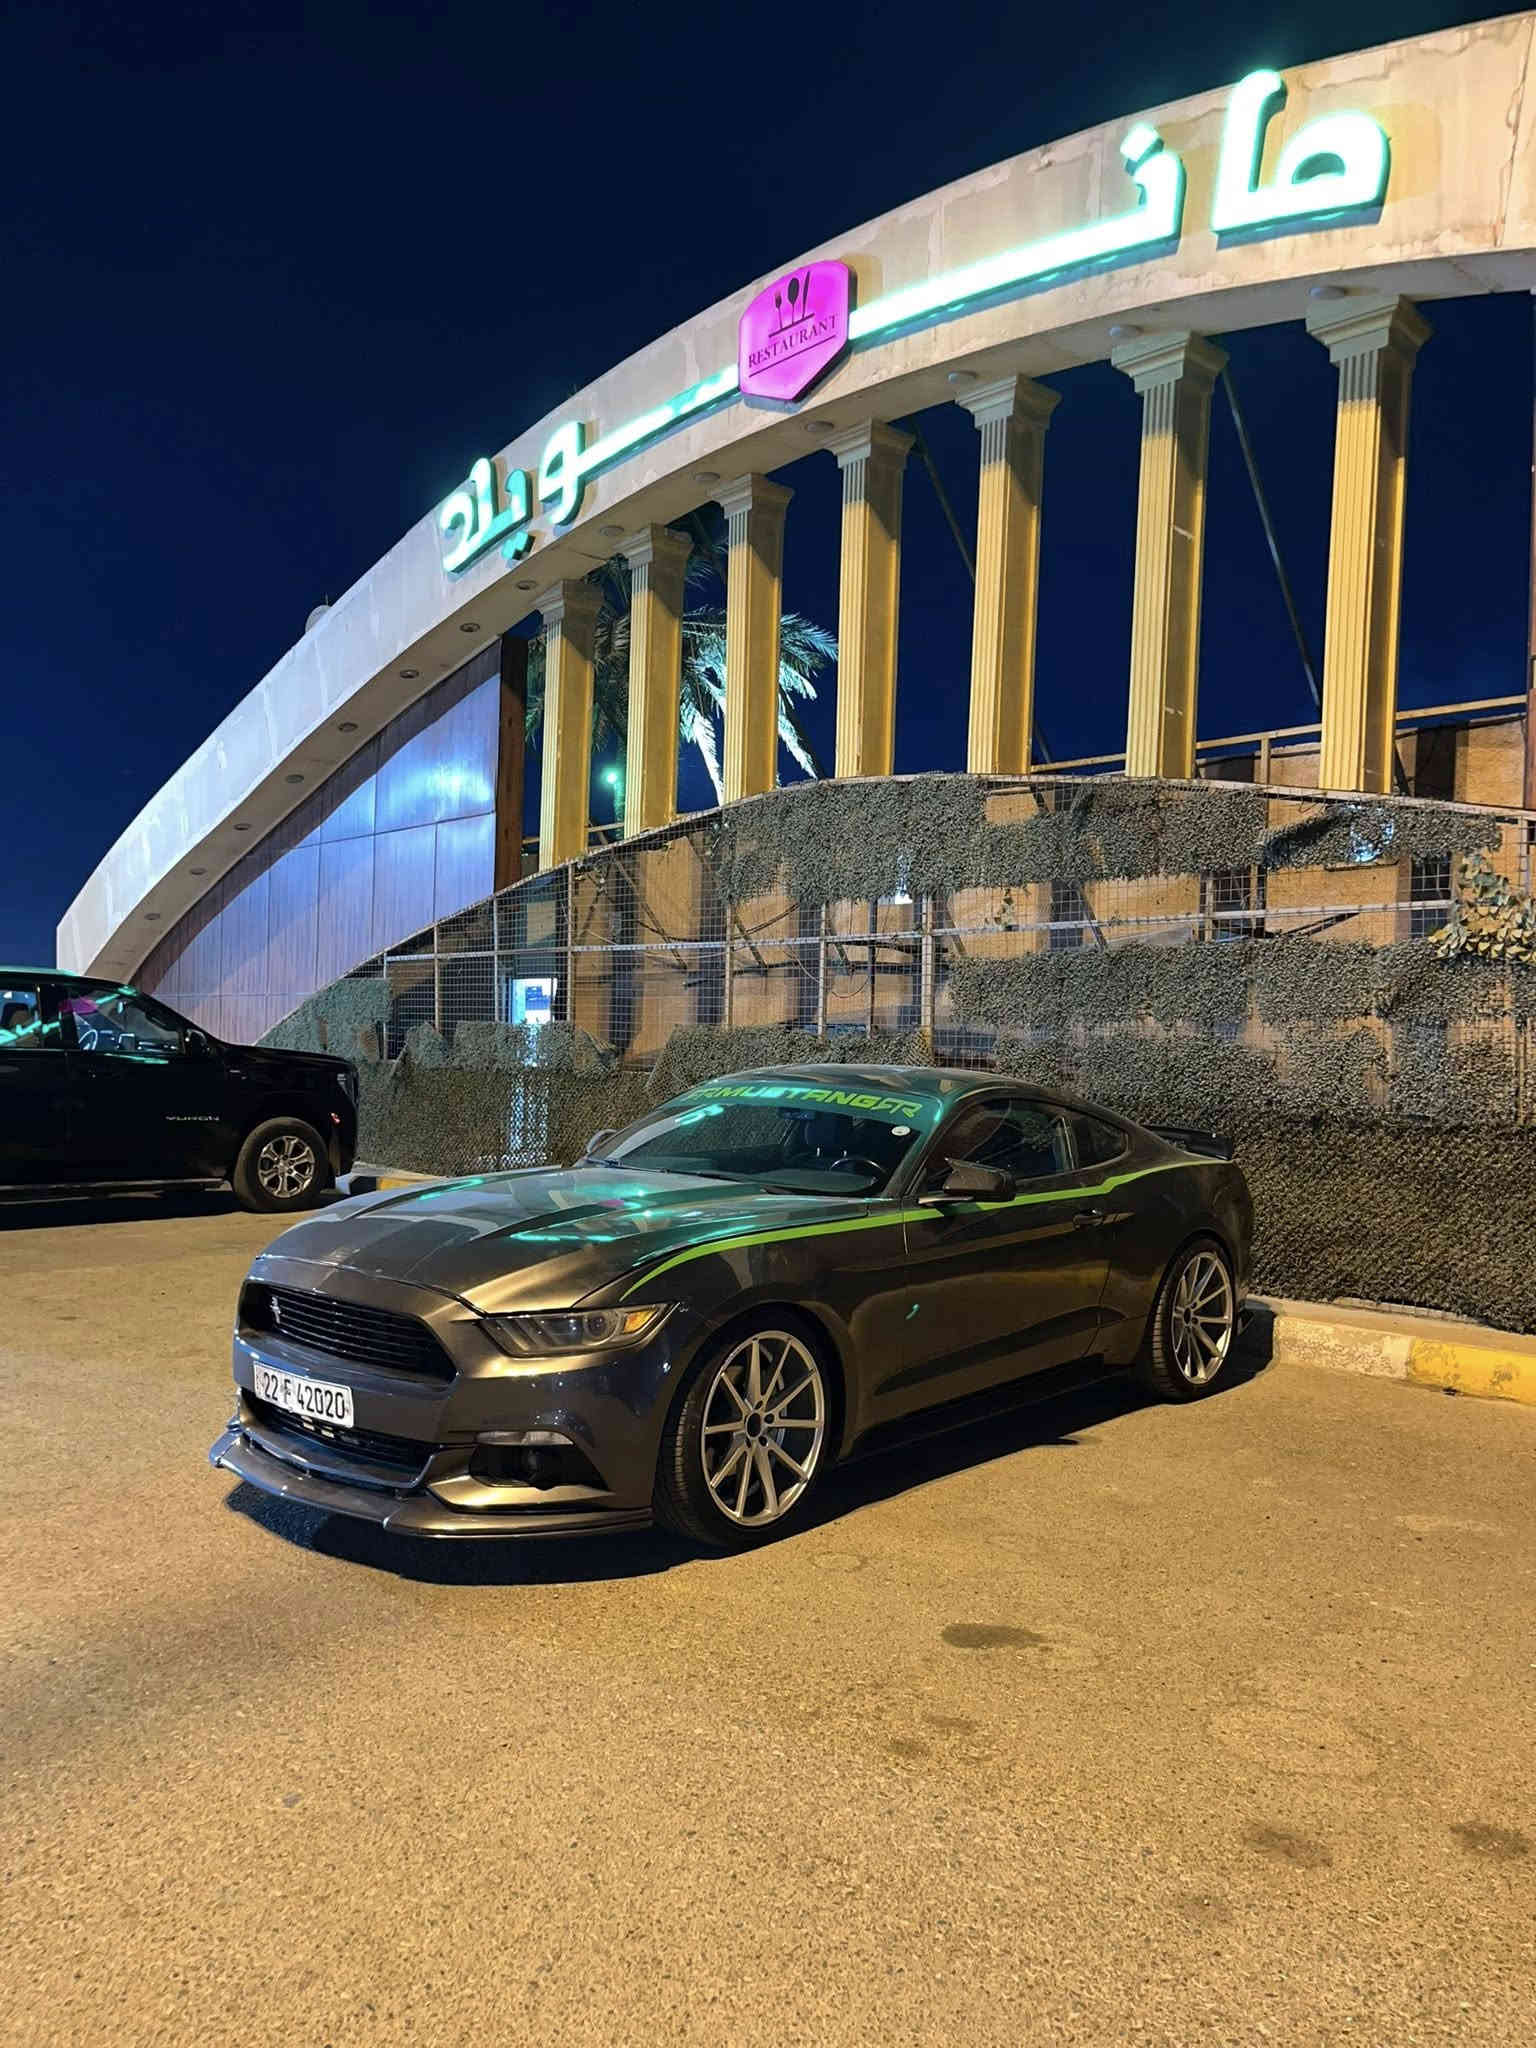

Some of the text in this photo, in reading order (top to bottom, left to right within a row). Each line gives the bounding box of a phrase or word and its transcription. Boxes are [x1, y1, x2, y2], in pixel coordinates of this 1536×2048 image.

[748, 313, 839, 368] RESTAURANT
[263, 1372, 279, 1402] 22
[283, 1377, 292, 1405] F
[297, 1383, 346, 1420] 42020
